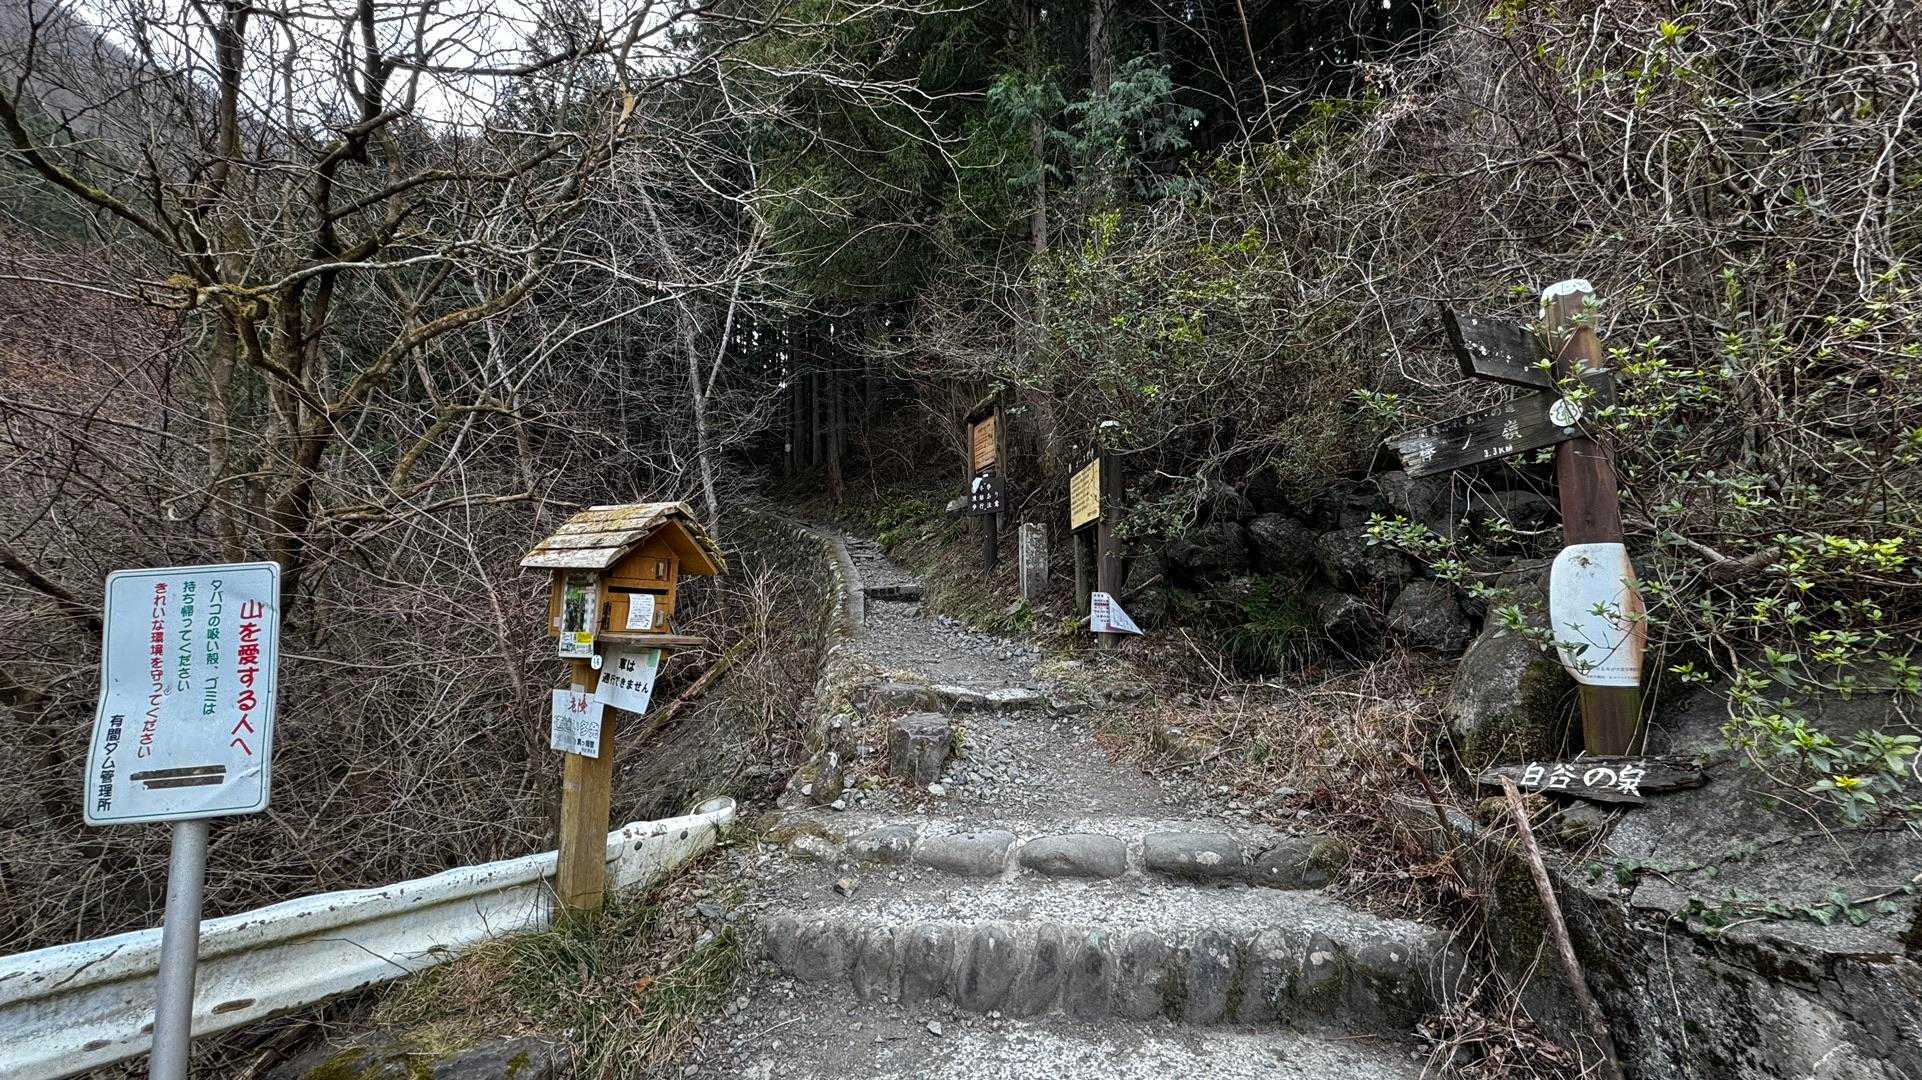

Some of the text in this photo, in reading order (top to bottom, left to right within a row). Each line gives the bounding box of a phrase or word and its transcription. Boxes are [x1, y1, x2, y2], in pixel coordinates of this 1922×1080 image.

[137, 582, 168, 759] きれいな環境を守ってください
[177, 580, 197, 692] 持ち帰ってください
[230, 598, 264, 756] 山を愛する人へ
[602, 672, 649, 694] 通行できません
[619, 657, 635, 672] 車は
[97, 714, 125, 812] 有間ダム管理所
[1520, 762, 1646, 797] 白谷の泉
